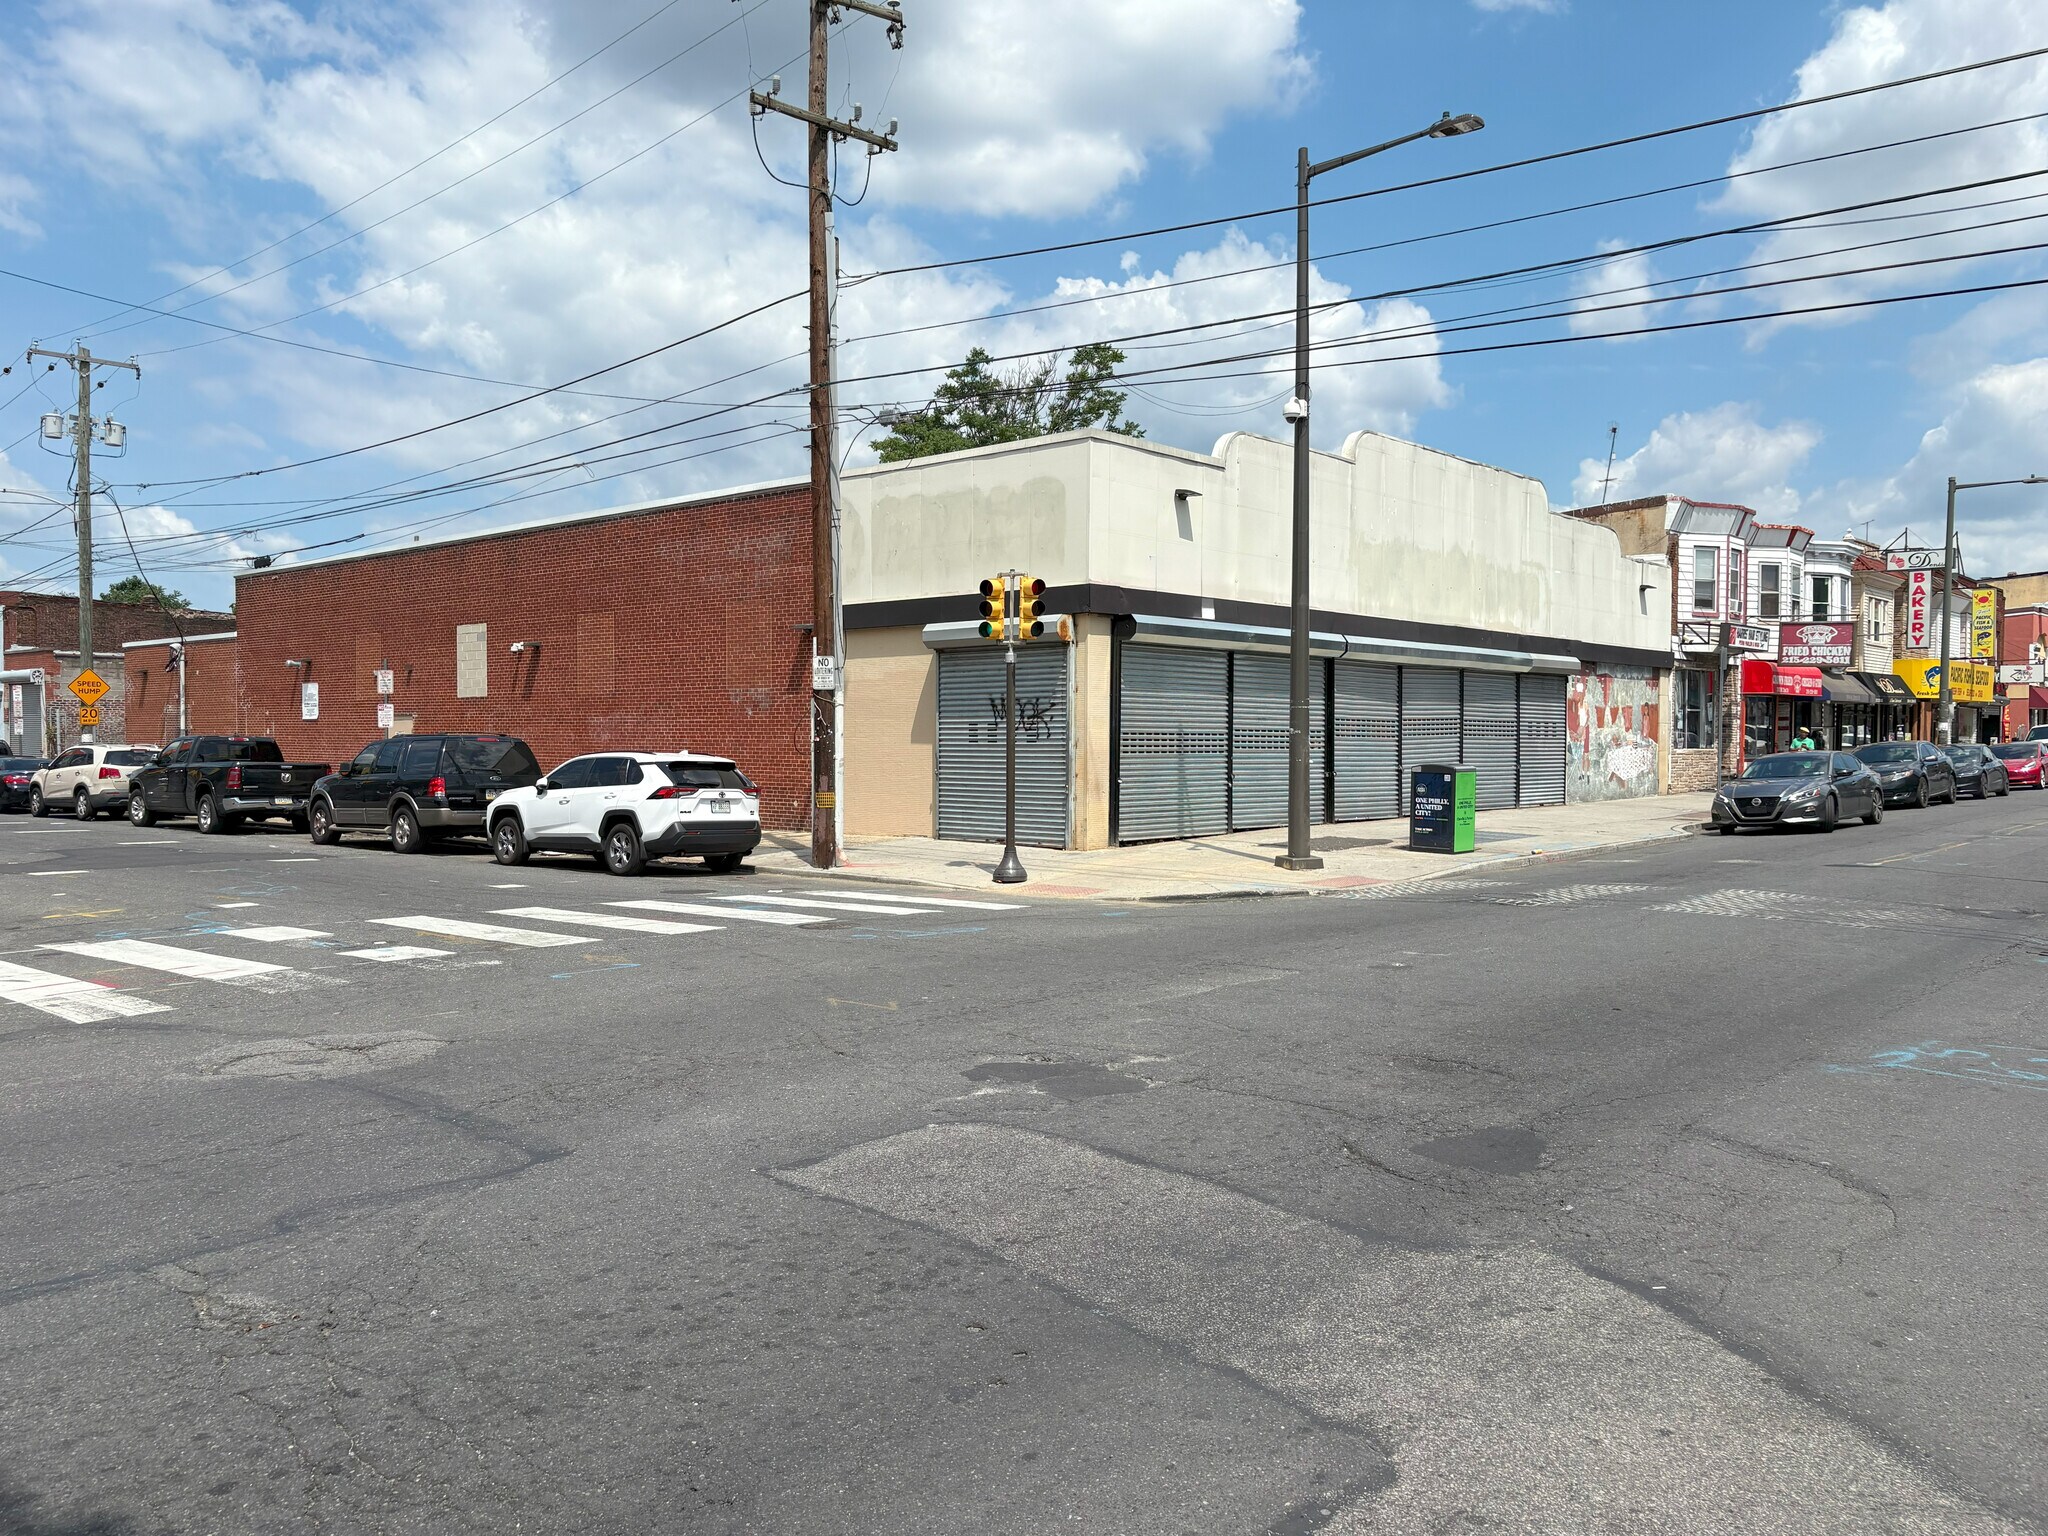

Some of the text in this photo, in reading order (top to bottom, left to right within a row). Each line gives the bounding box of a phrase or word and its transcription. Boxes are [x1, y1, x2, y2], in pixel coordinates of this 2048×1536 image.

[1911, 572, 1927, 646] BAKERY
[1782, 646, 1851, 656] FRIED CHICKEN
[818, 657, 829, 667] NO
[78, 687, 101, 695] HUMP
[81, 708, 98, 719] 20
